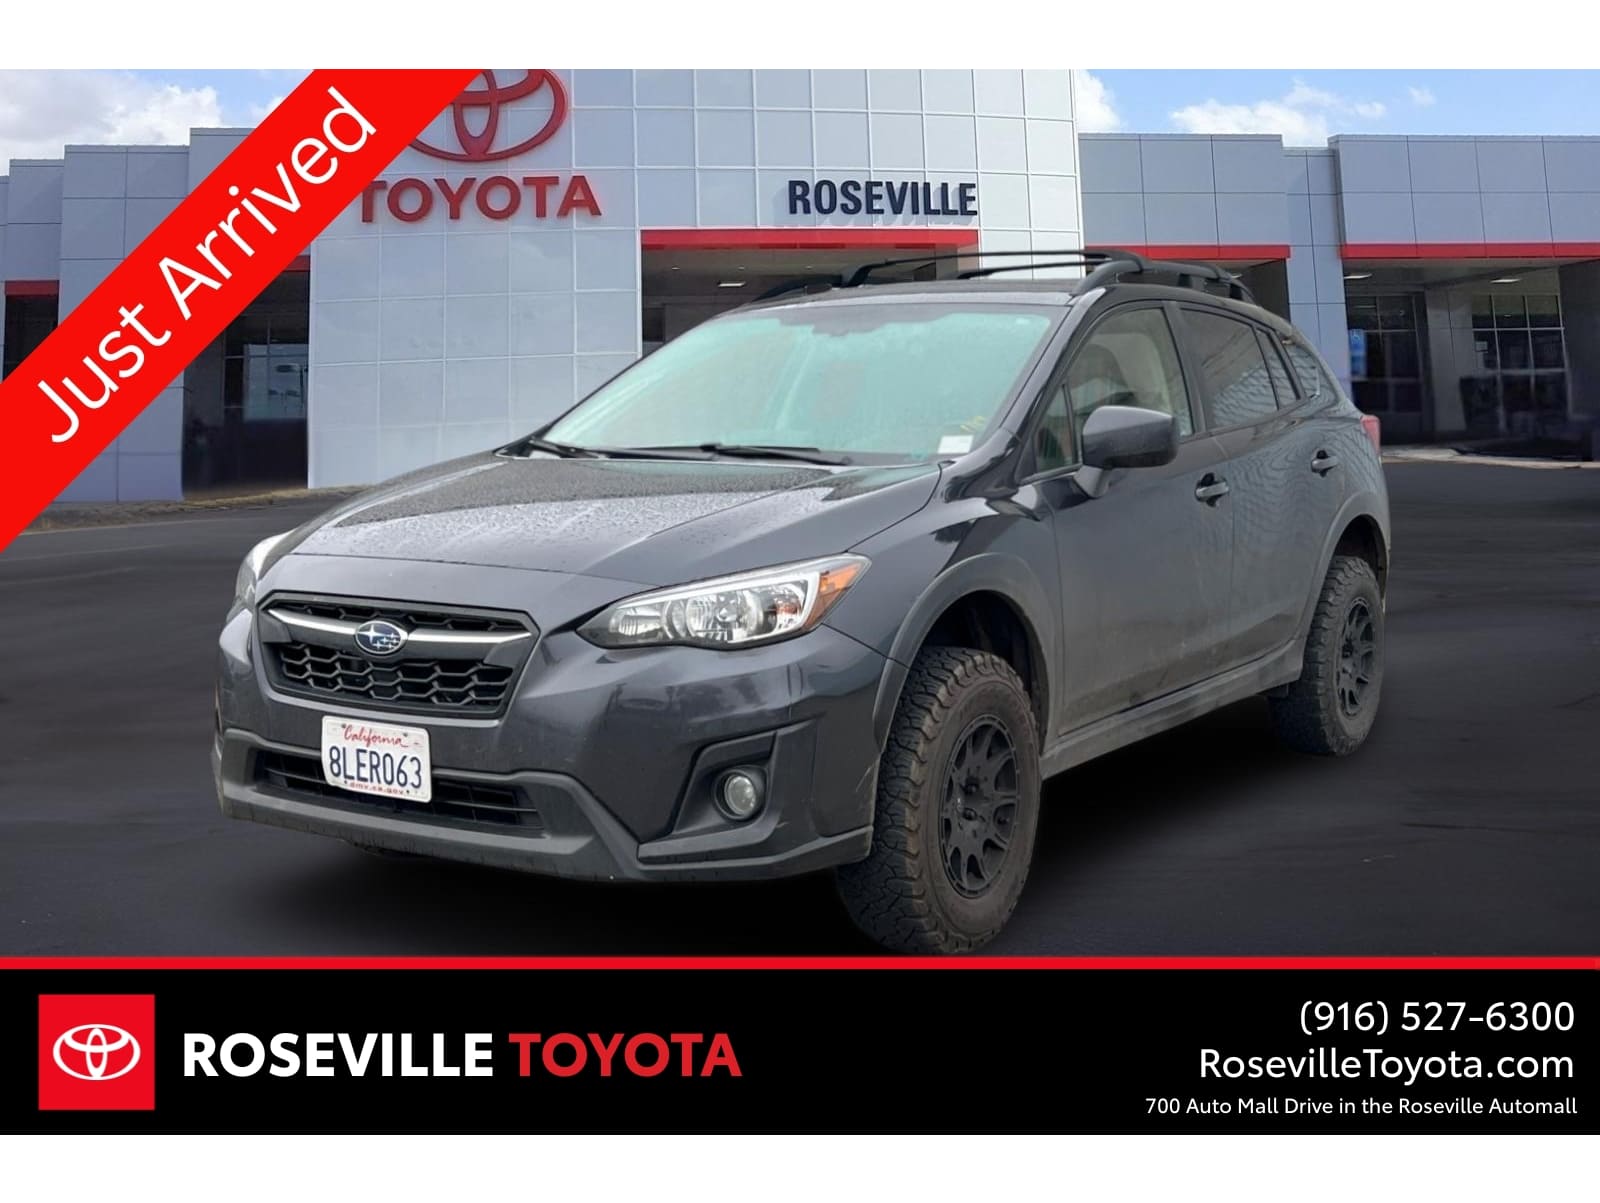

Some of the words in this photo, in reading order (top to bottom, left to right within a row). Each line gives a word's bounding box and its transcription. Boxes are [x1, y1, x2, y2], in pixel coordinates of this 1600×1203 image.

[788, 179, 978, 216] ROSEVILLE
[343, 724, 408, 748] California
[329, 746, 422, 789] 8LER063
